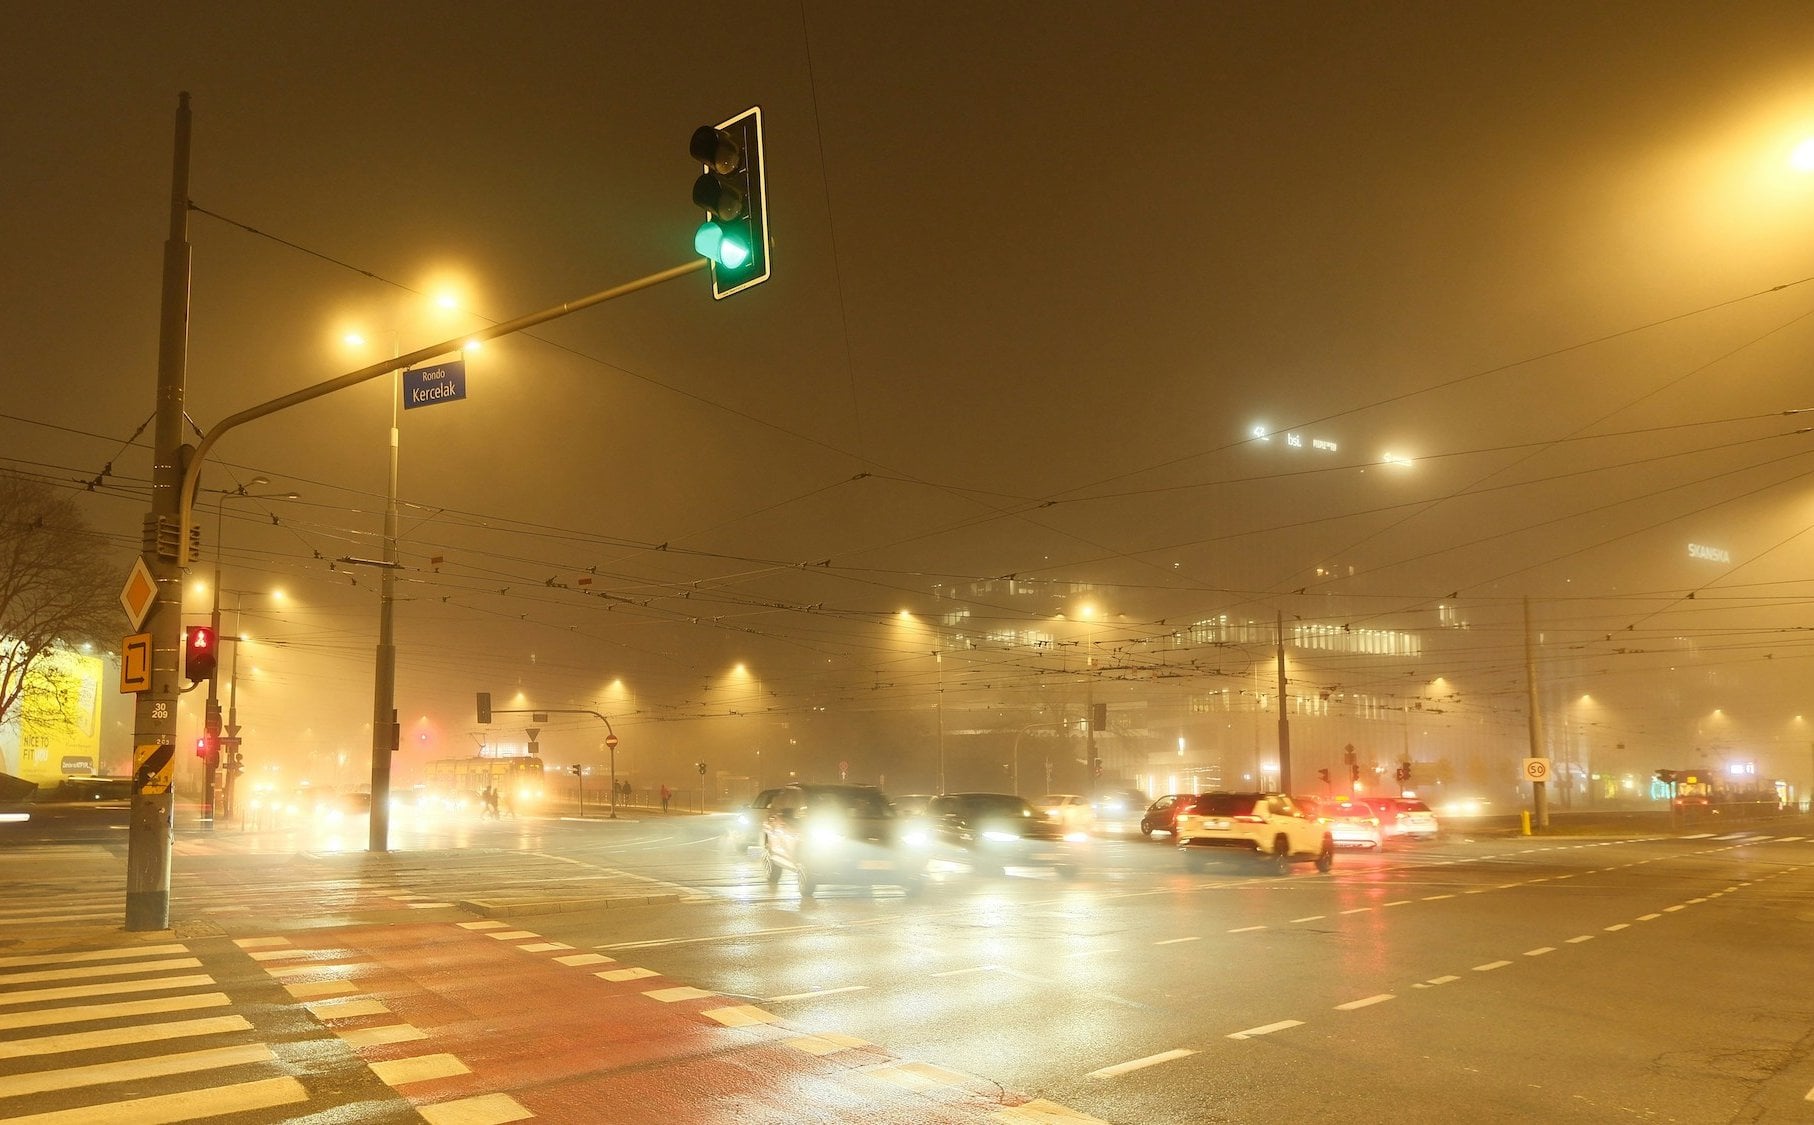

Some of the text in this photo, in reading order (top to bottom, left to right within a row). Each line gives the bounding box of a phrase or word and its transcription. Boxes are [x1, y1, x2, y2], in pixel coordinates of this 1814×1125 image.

[422, 368, 446, 382] Rondo
[412, 380, 456, 403] Kercelak
[1687, 543, 1730, 563] SKANSKA
[155, 703, 166, 711] 30
[151, 710, 168, 719] 209
[23, 735, 50, 748] NICE TO
[22, 748, 35, 761] FIT
[1530, 765, 1544, 774] 50
